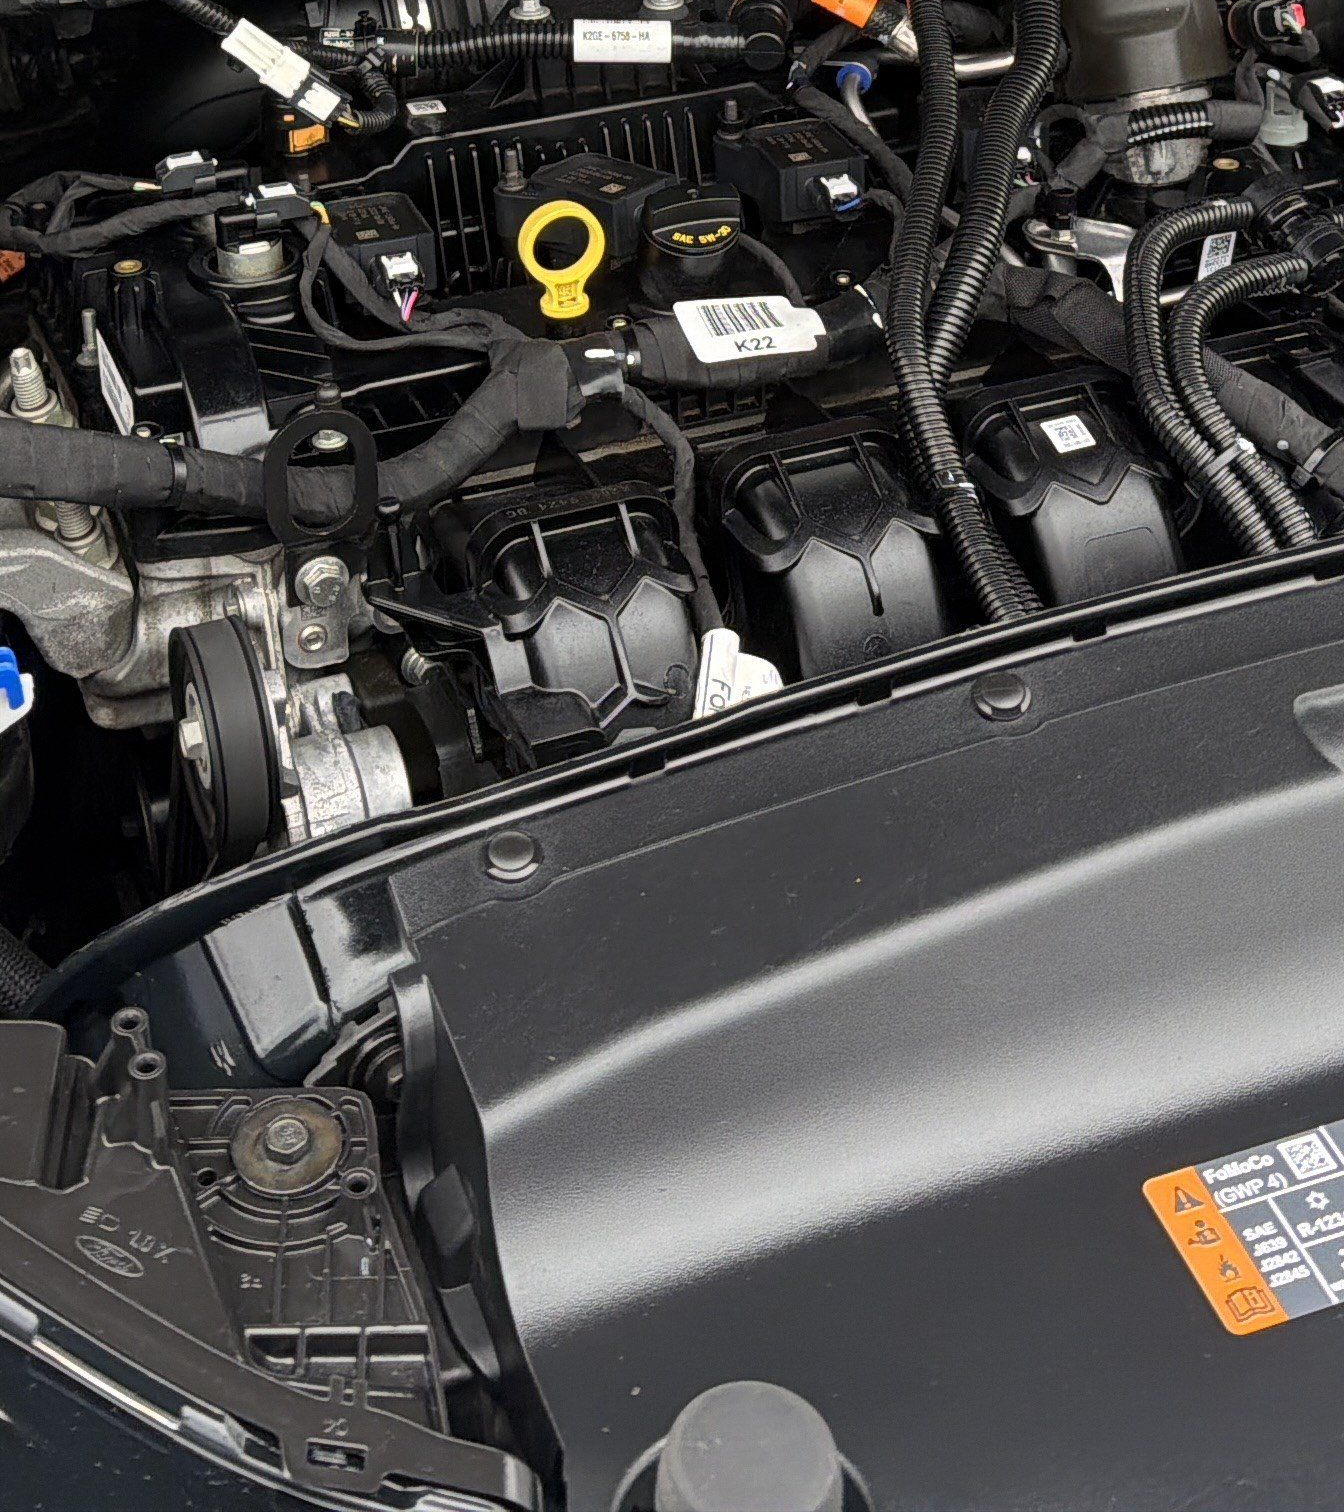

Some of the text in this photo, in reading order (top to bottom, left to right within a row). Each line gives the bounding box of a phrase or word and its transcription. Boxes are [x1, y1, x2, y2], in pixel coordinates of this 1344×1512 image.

[672, 232, 694, 245] SAE
[734, 335, 777, 353] K22
[1203, 1154, 1275, 1184] FoMoCo
[1214, 1172, 1289, 1208] (GWP 4)
[1242, 1220, 1278, 1242] SAE
